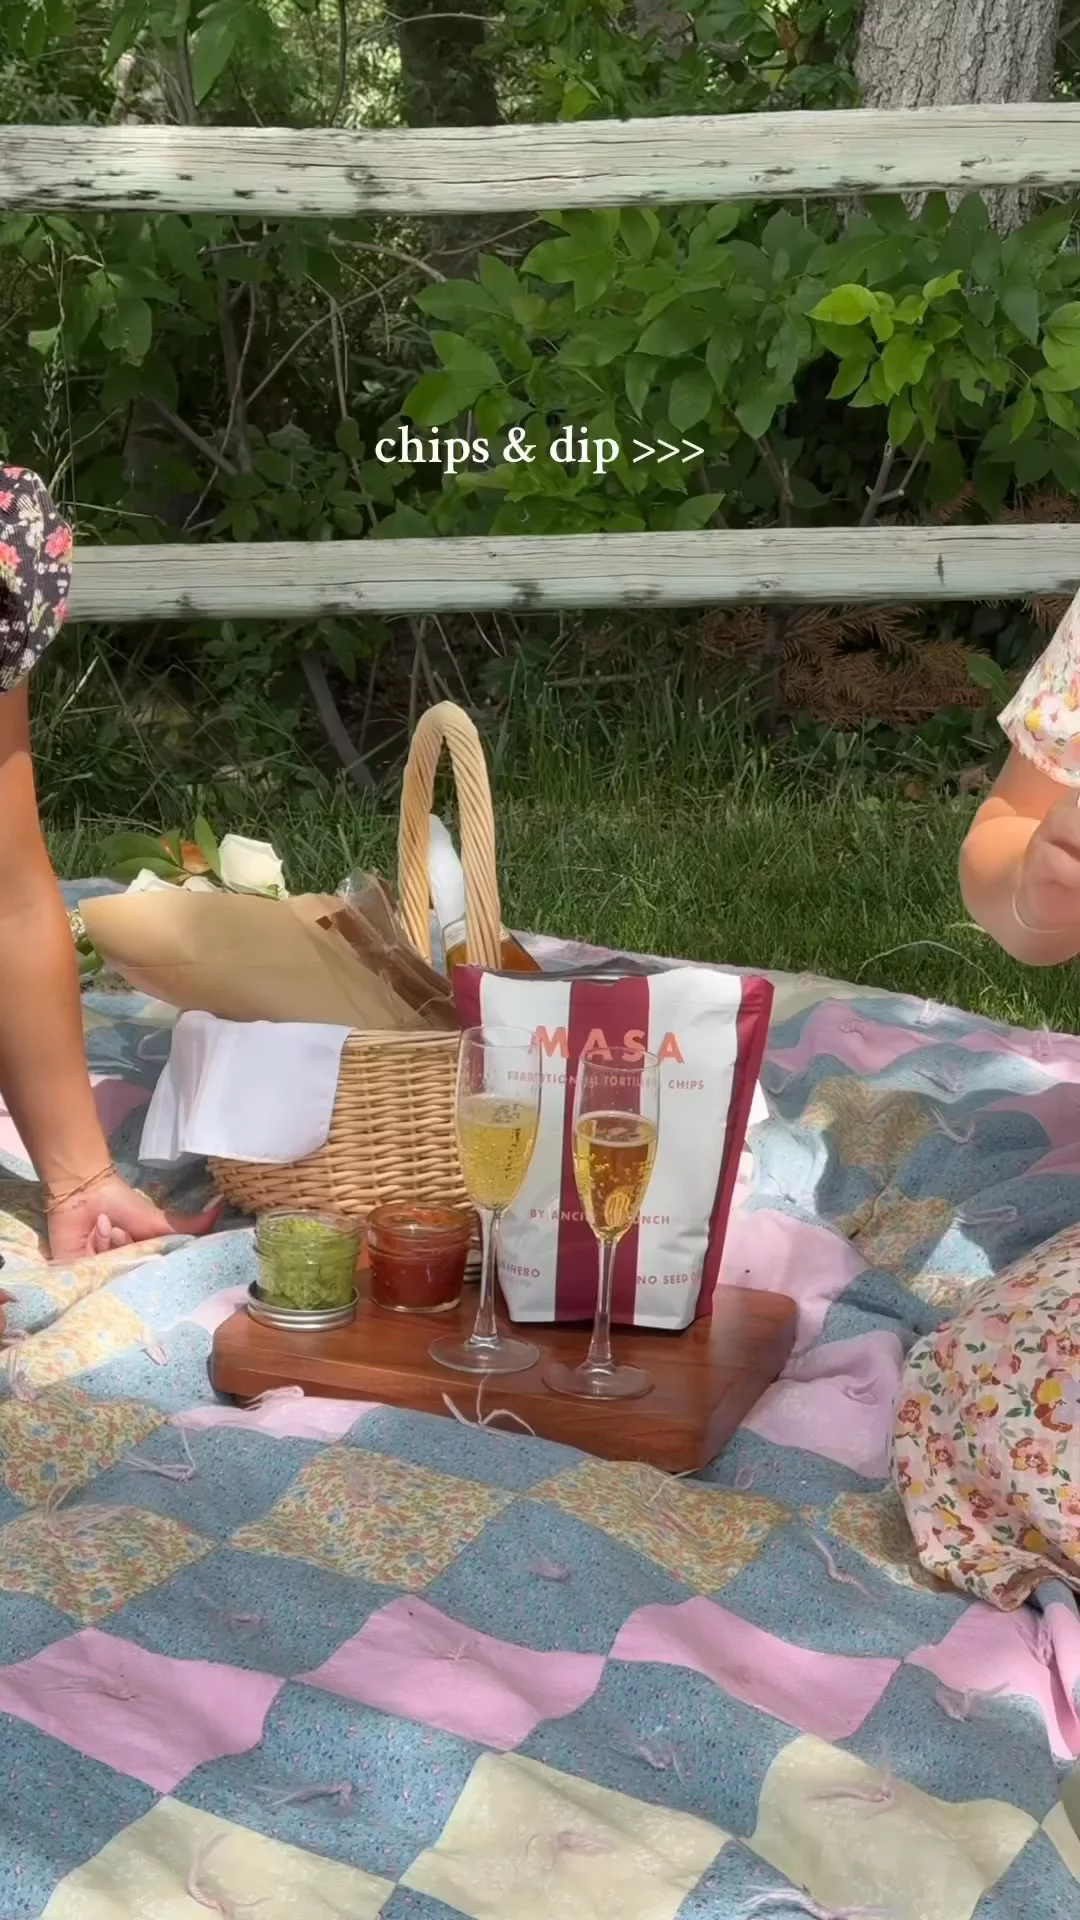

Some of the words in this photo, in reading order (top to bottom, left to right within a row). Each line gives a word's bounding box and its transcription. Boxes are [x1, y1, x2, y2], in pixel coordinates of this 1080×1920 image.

[528, 1025, 686, 1064] MASA
[603, 1075, 657, 1089] TORTIL
[668, 1079, 704, 1090] CHIPS
[530, 1208, 545, 1218] BY
[636, 1275, 658, 1285] NO
[663, 1273, 688, 1285] SEED
